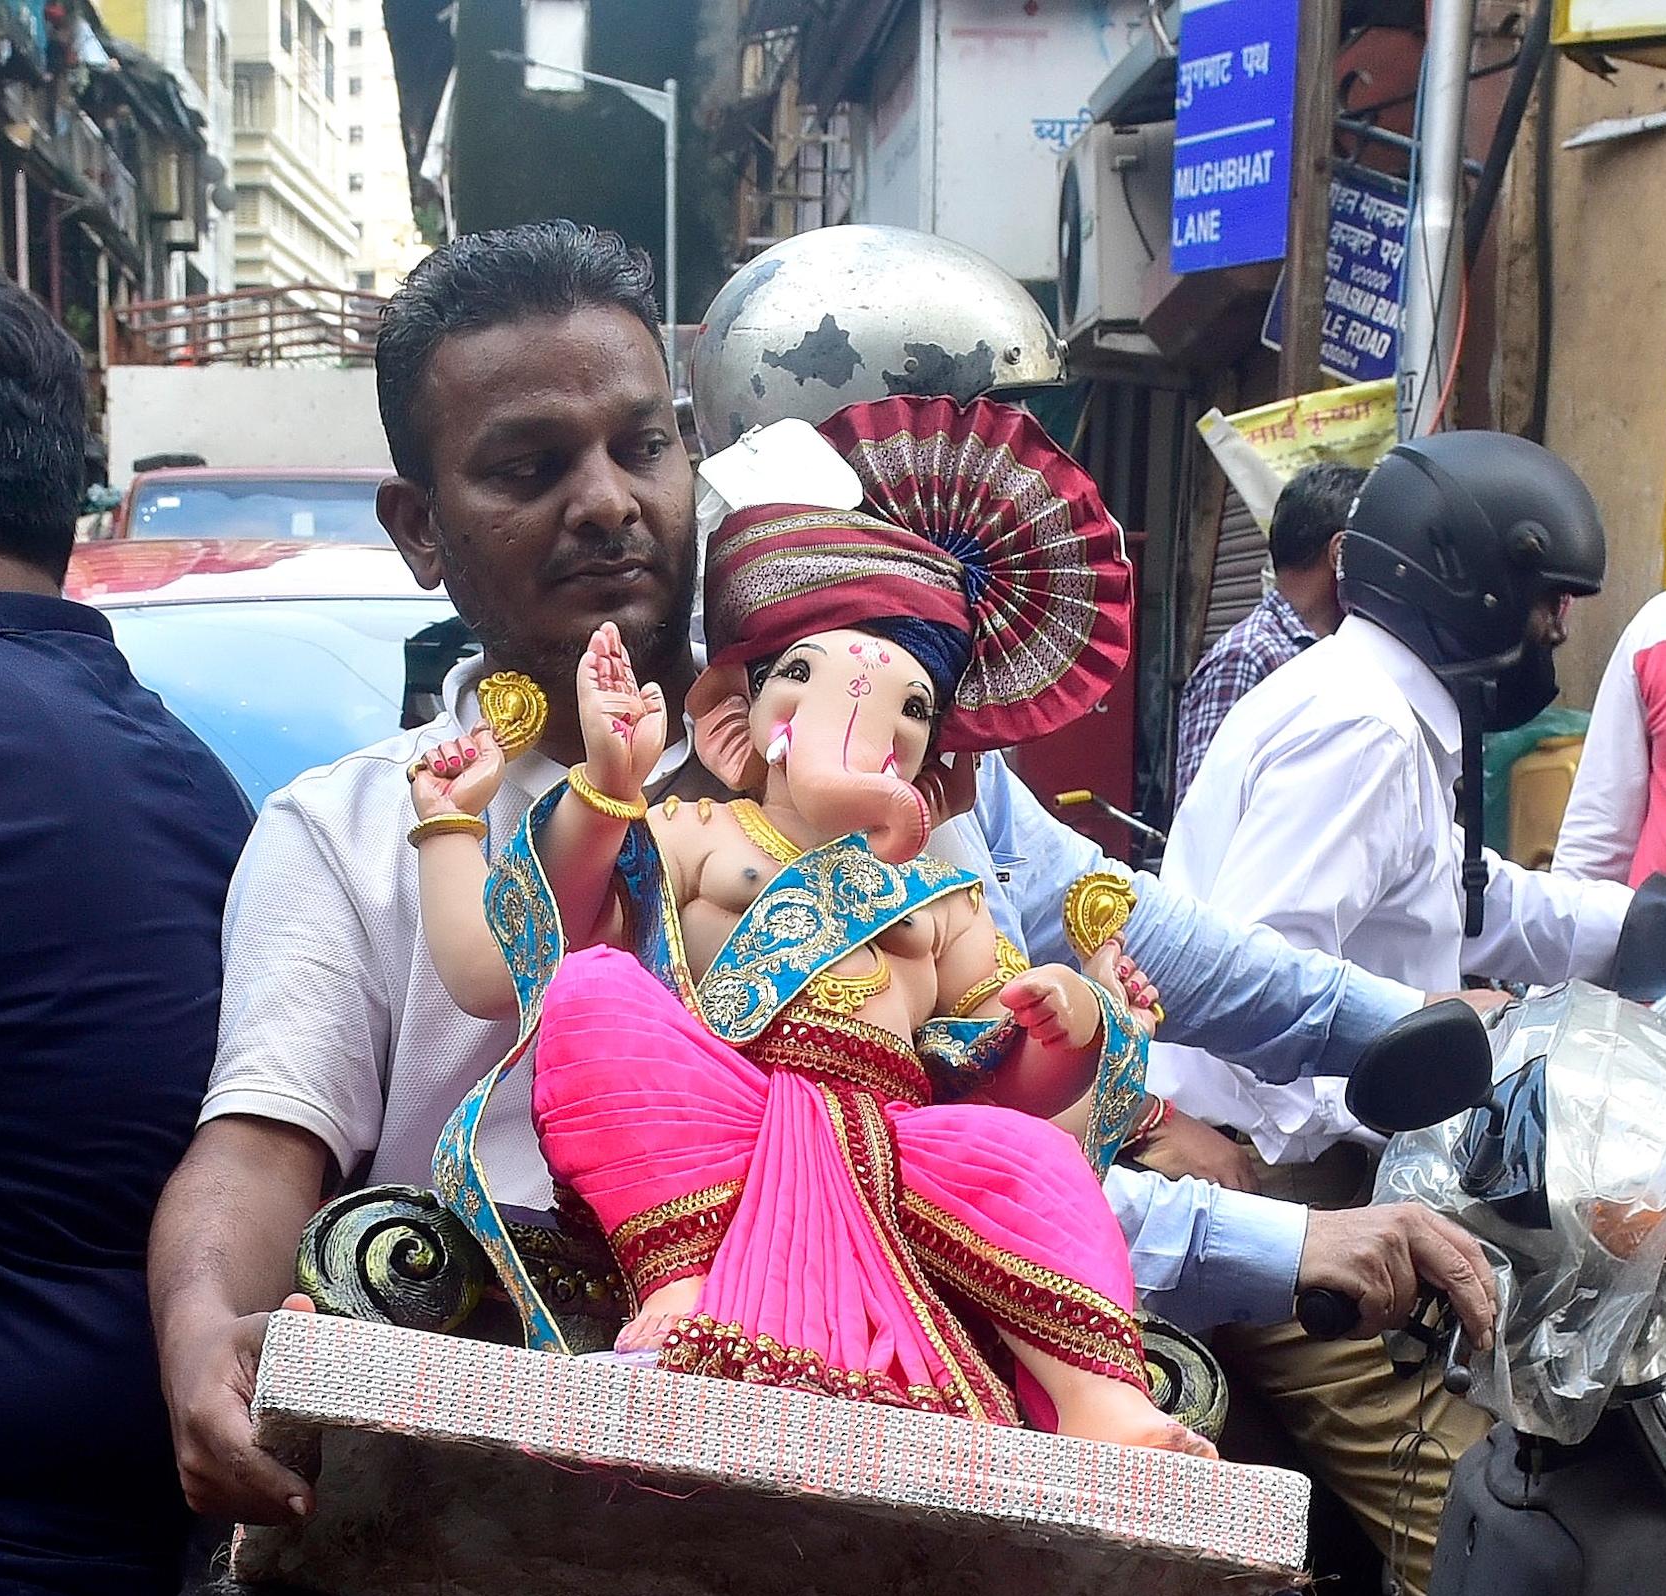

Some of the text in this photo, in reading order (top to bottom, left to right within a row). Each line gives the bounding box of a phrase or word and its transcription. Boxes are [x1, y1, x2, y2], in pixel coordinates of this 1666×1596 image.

[1241, 41, 1271, 78] पथ
[1173, 150, 1275, 200] MUGHBHAT
[1172, 209, 1222, 247] LANE
[1344, 319, 1393, 360] ROAD
